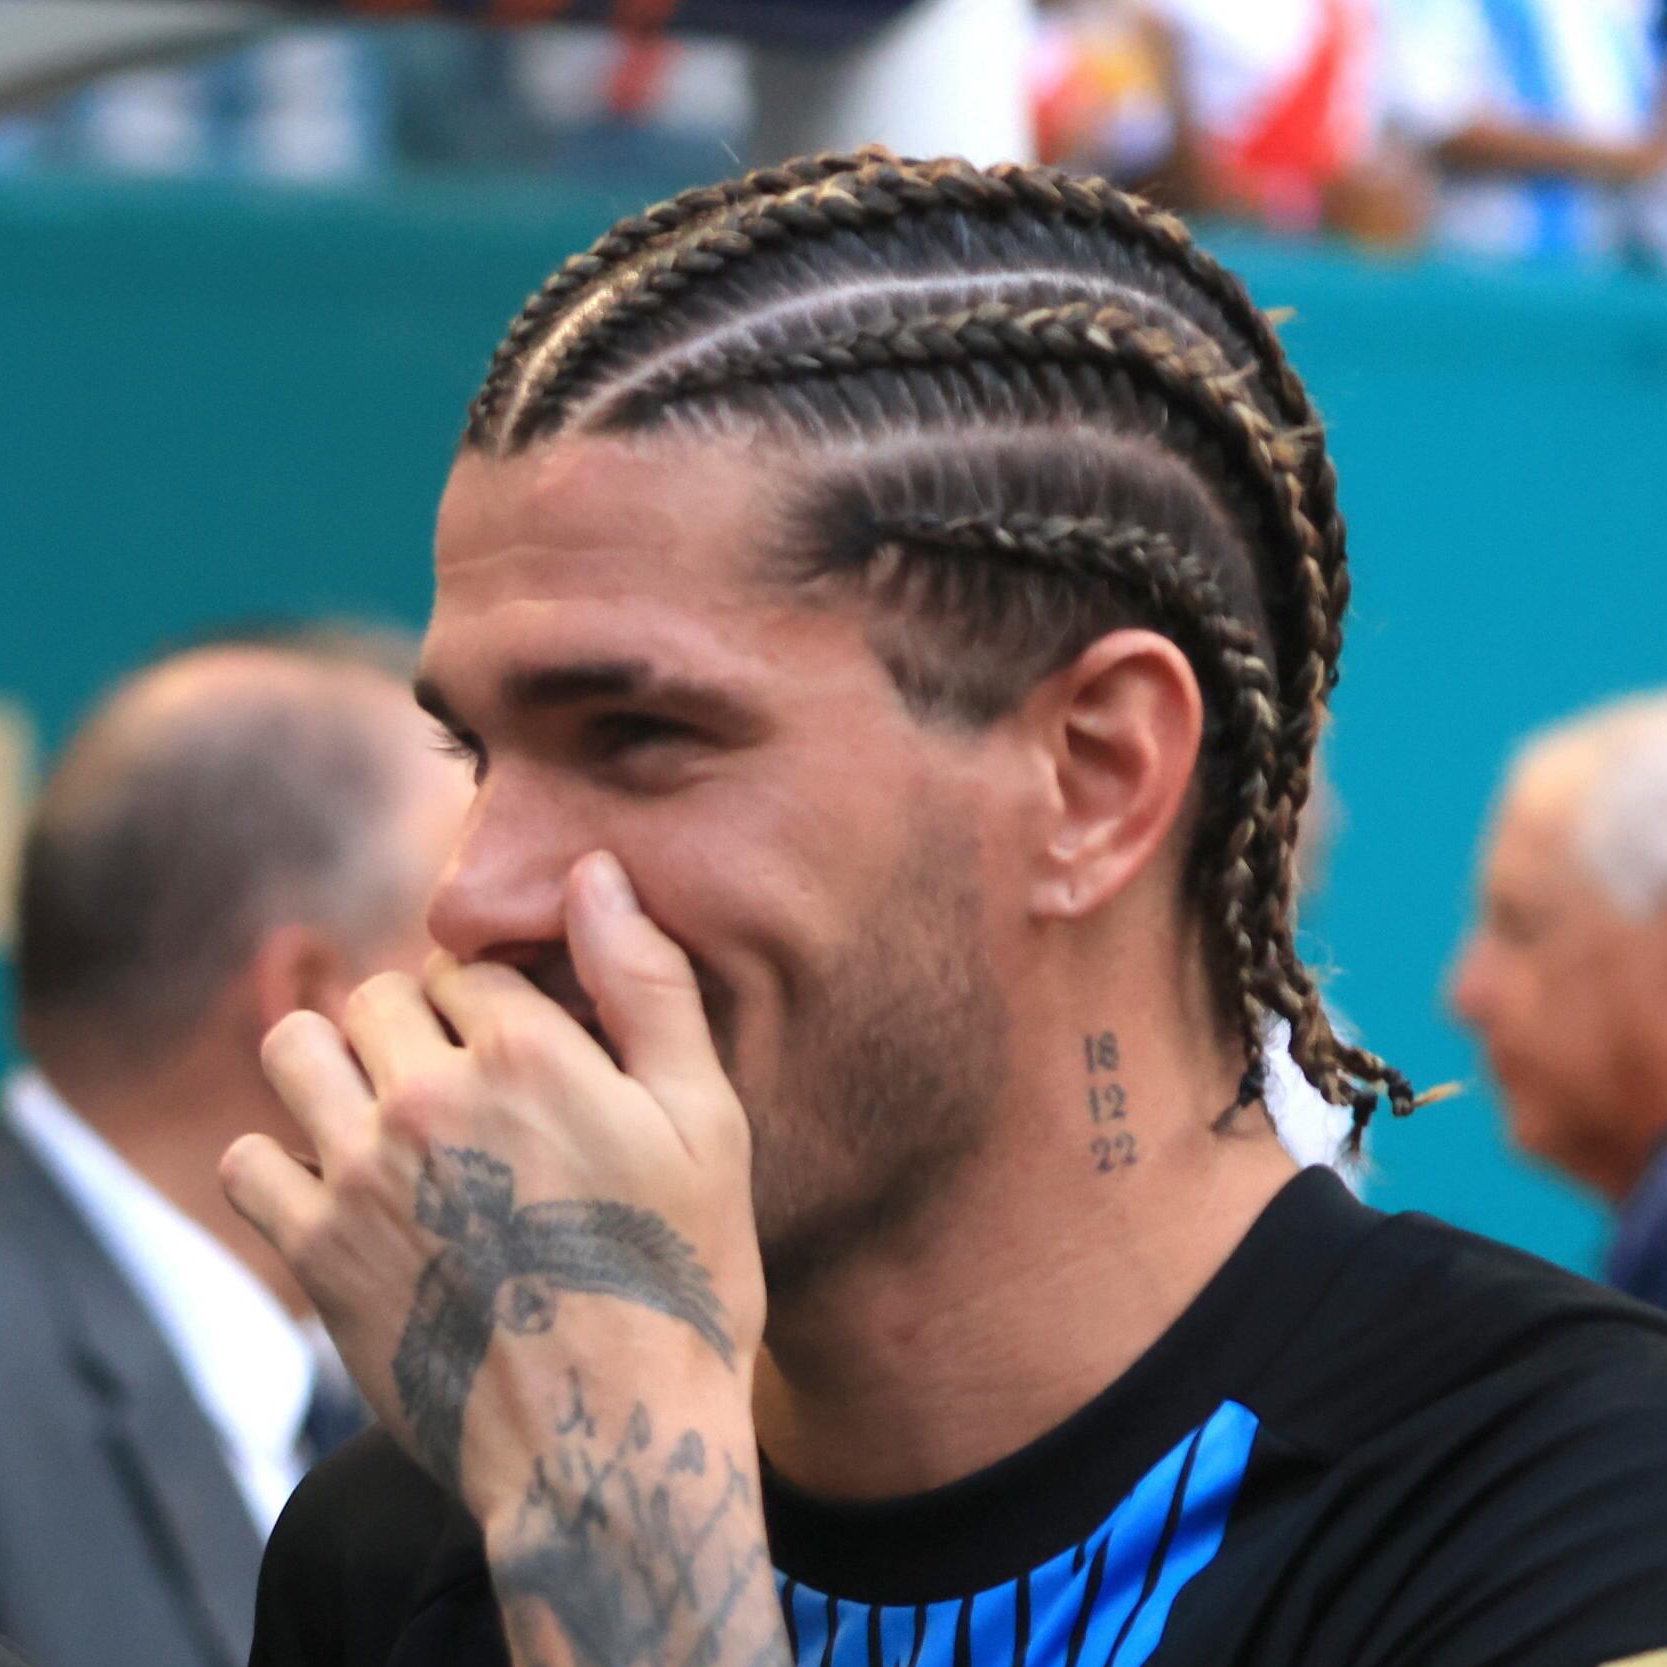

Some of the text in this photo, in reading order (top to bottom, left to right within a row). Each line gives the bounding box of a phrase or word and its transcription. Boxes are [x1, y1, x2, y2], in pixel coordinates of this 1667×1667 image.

[1084, 1031, 1118, 1073] 18
[1089, 1084, 1126, 1122] 12
[1091, 1132, 1137, 1173] 22
